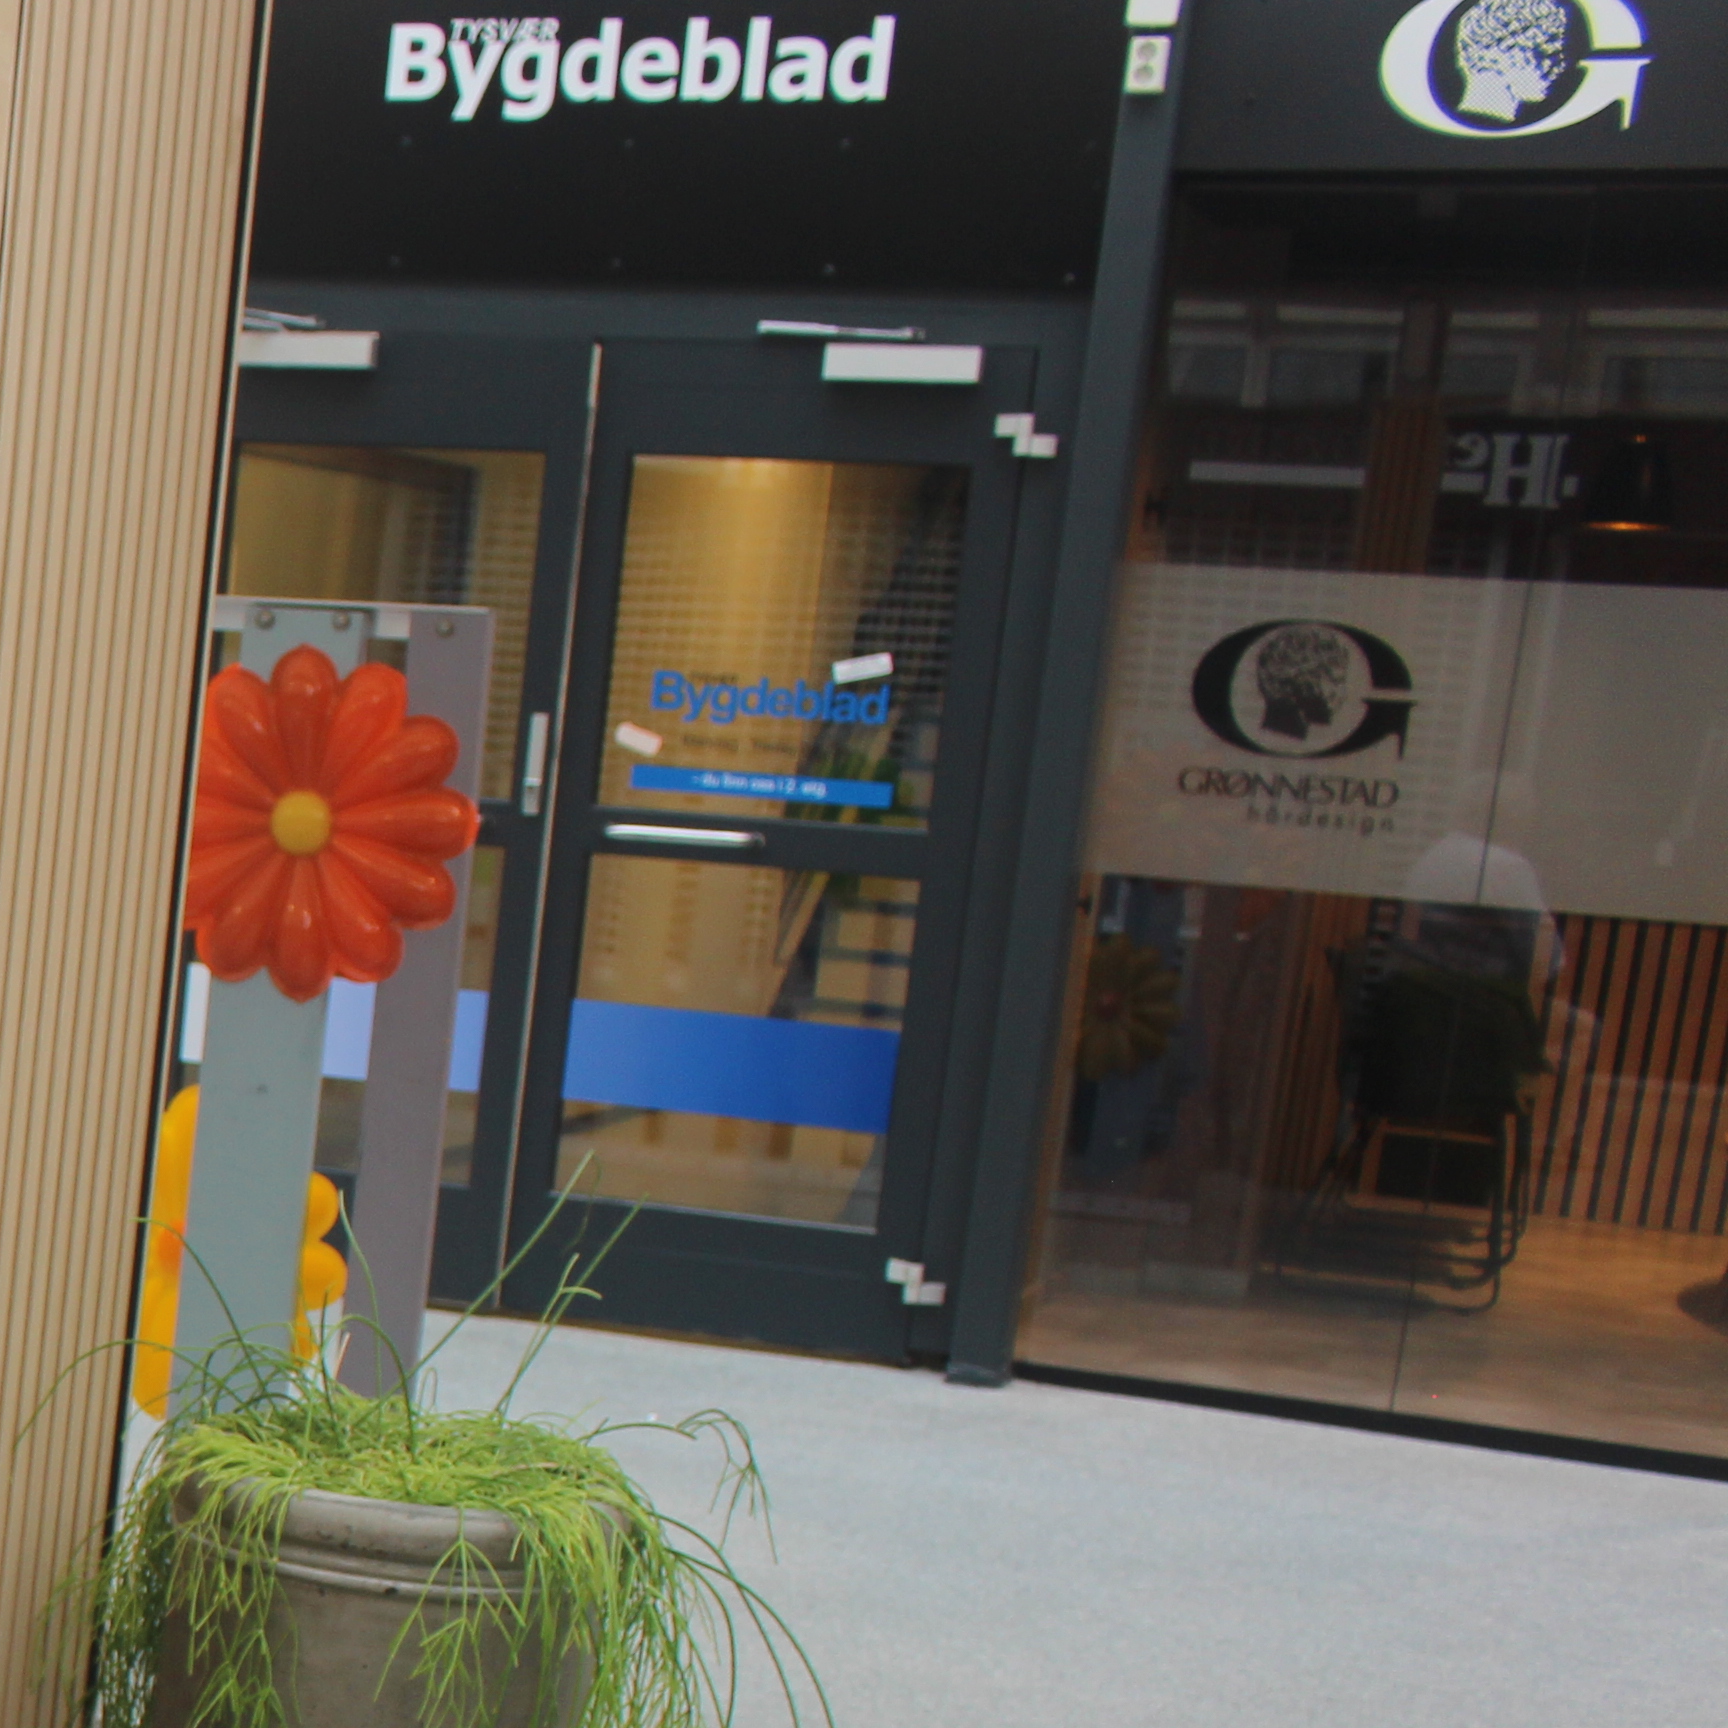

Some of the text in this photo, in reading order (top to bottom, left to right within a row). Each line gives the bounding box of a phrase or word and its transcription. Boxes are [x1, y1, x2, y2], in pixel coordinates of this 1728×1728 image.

[385, 15, 896, 122] Bygdeblad
[651, 669, 890, 725] Bygdeblad
[1178, 766, 1399, 808] GRØNNESTAD
